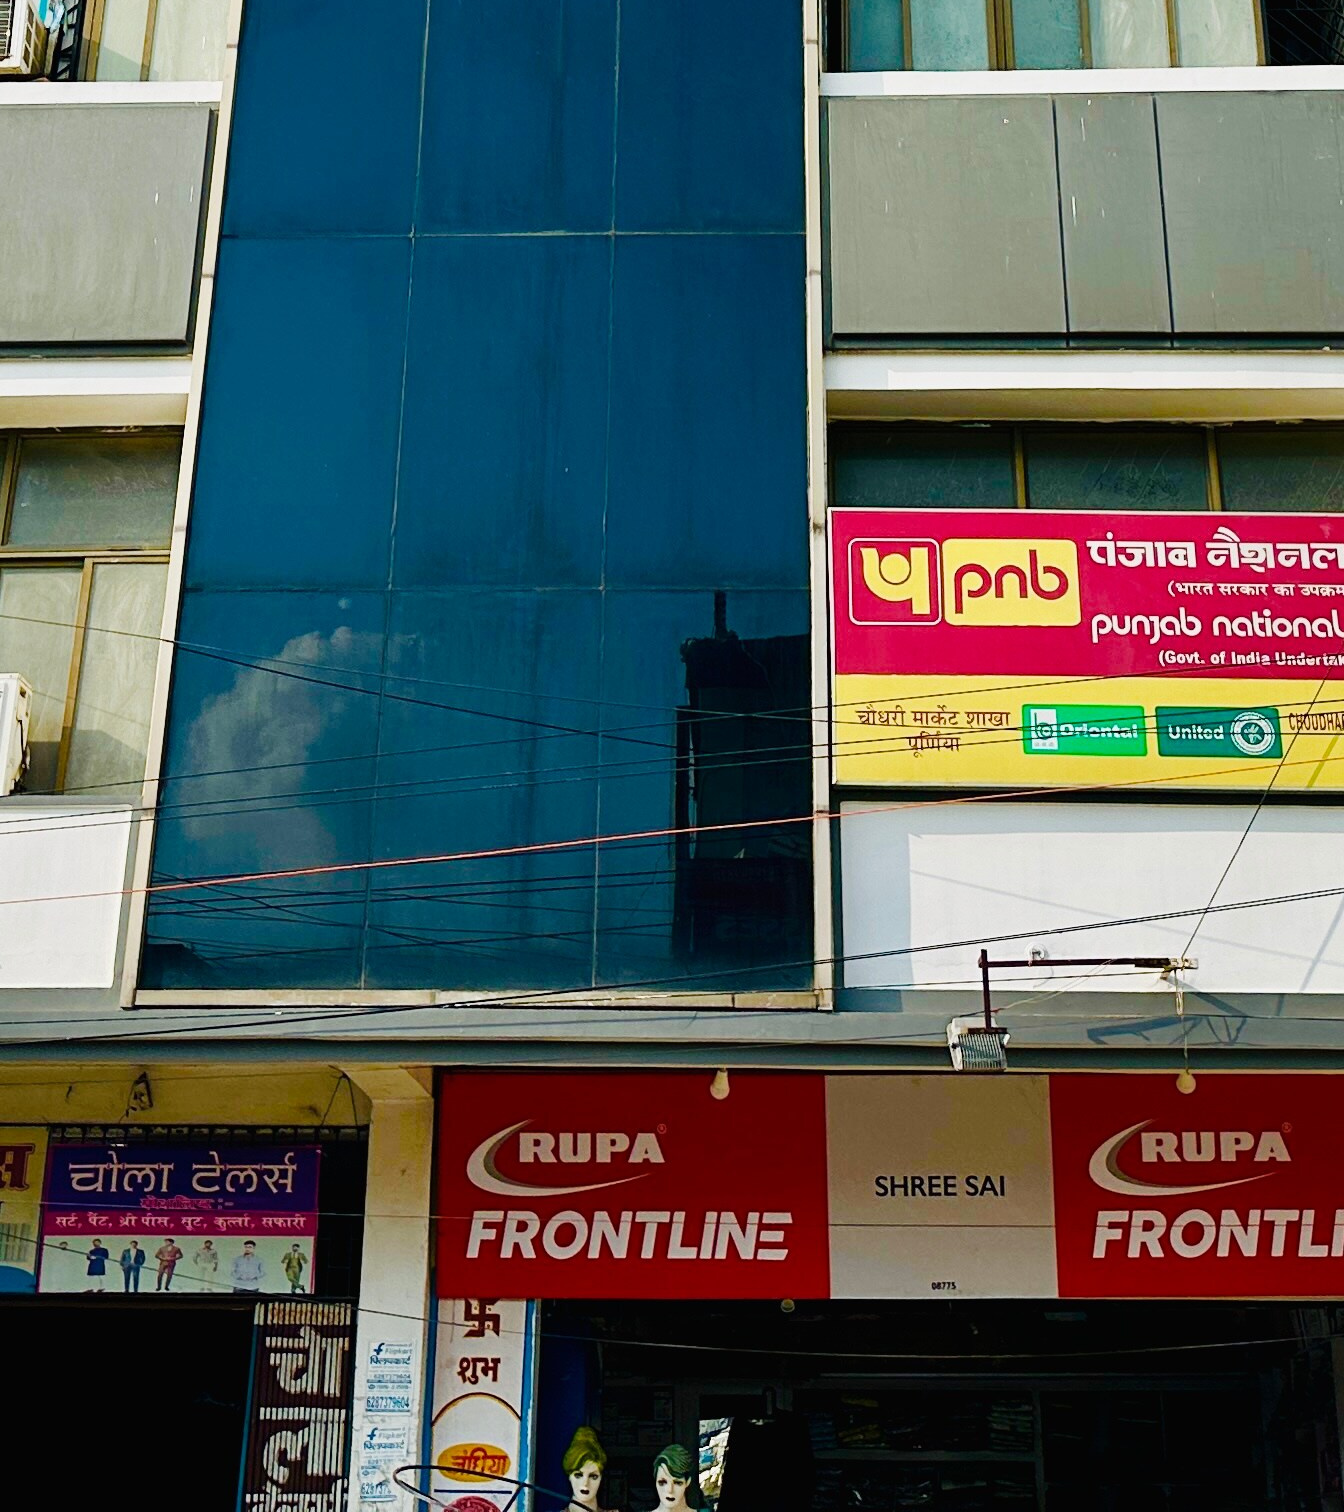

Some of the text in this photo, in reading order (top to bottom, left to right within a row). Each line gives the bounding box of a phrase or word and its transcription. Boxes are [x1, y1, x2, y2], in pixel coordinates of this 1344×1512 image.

[1086, 531, 1197, 567] पंजाब
[954, 549, 1069, 615] pnb
[1218, 583, 1267, 597] सरकार
[1272, 583, 1295, 597] का
[1091, 607, 1202, 644] punjab
[1158, 650, 1206, 667] (Govt.
[1210, 651, 1226, 665] of
[1231, 651, 1271, 666] India
[965, 711, 1010, 728] शाखा
[1167, 724, 1224, 740] United
[519, 1132, 665, 1163] RUPA
[1141, 1131, 1291, 1162] RUPA
[69, 1151, 297, 1194] चोला टेलर्स
[875, 1175, 1005, 1197] SHREE SAI
[466, 1210, 793, 1260] FRONTLINE
[457, 1357, 500, 1384] शुभ
